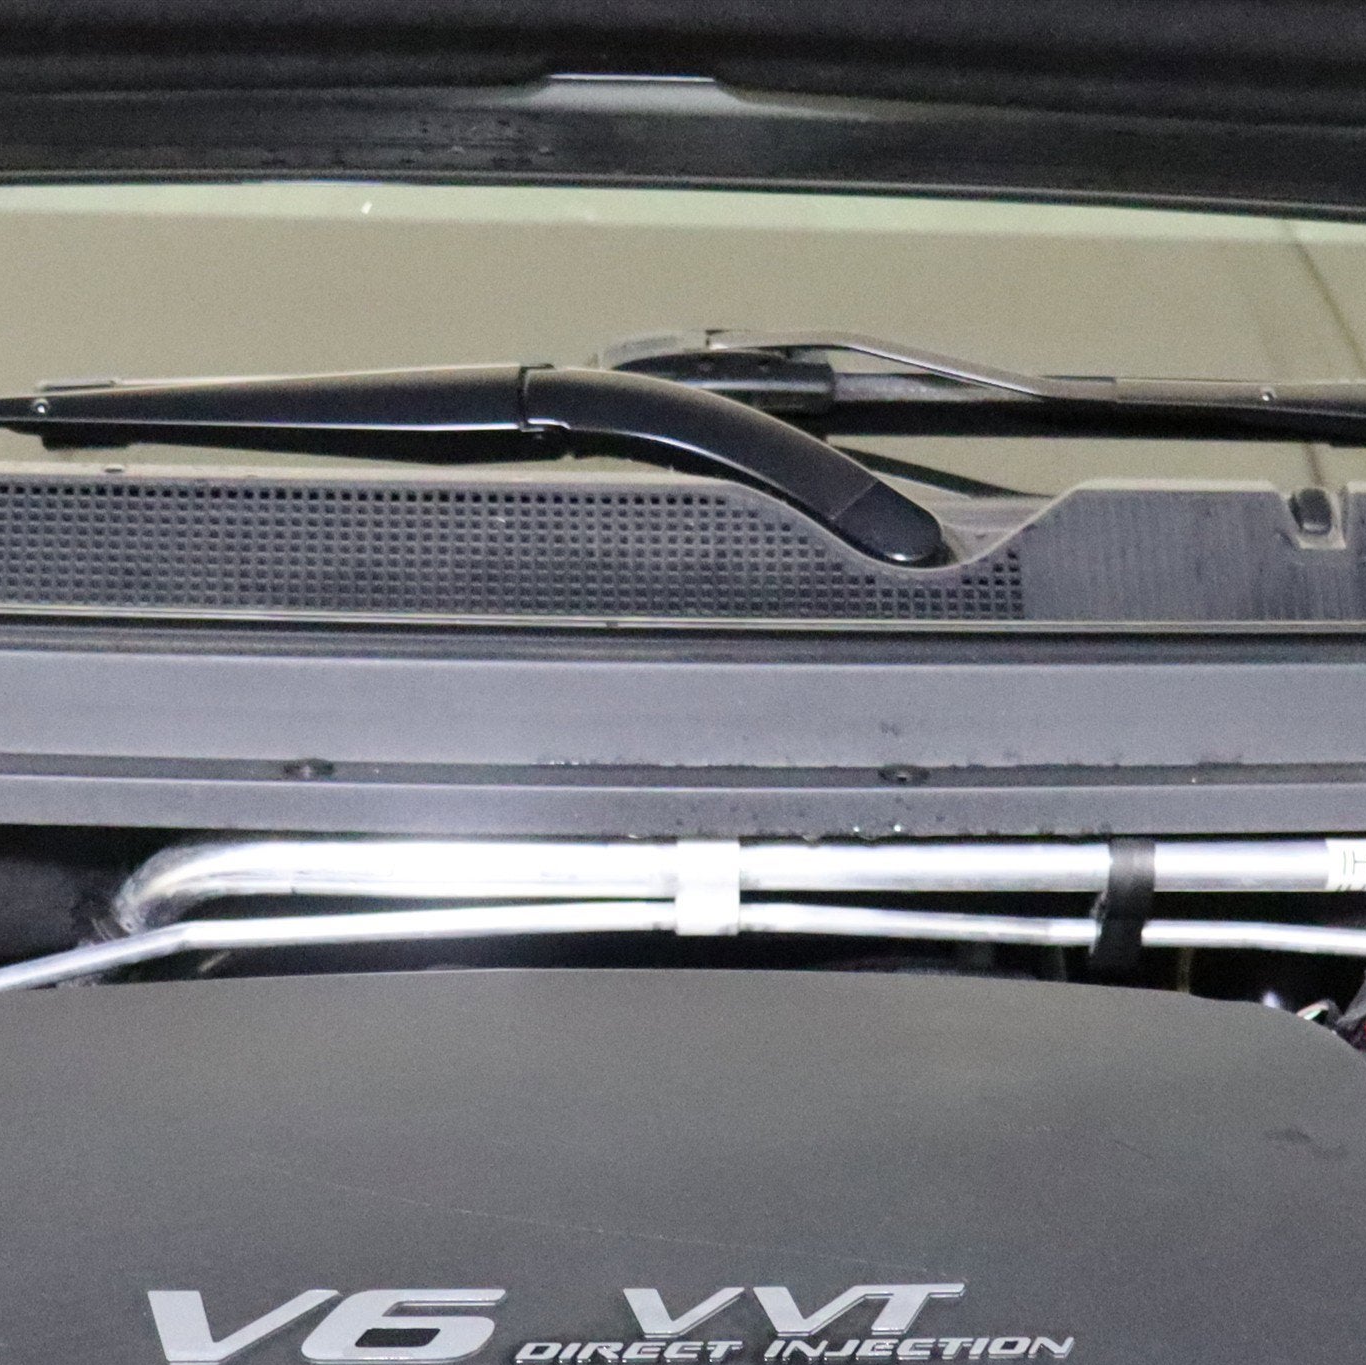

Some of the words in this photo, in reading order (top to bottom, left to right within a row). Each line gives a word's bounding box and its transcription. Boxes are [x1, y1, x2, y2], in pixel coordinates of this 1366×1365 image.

[147, 1289, 505, 1365] V6
[622, 1283, 967, 1340] VVT
[512, 1338, 742, 1365] DIRECT
[765, 1335, 1075, 1364] INJECTION
